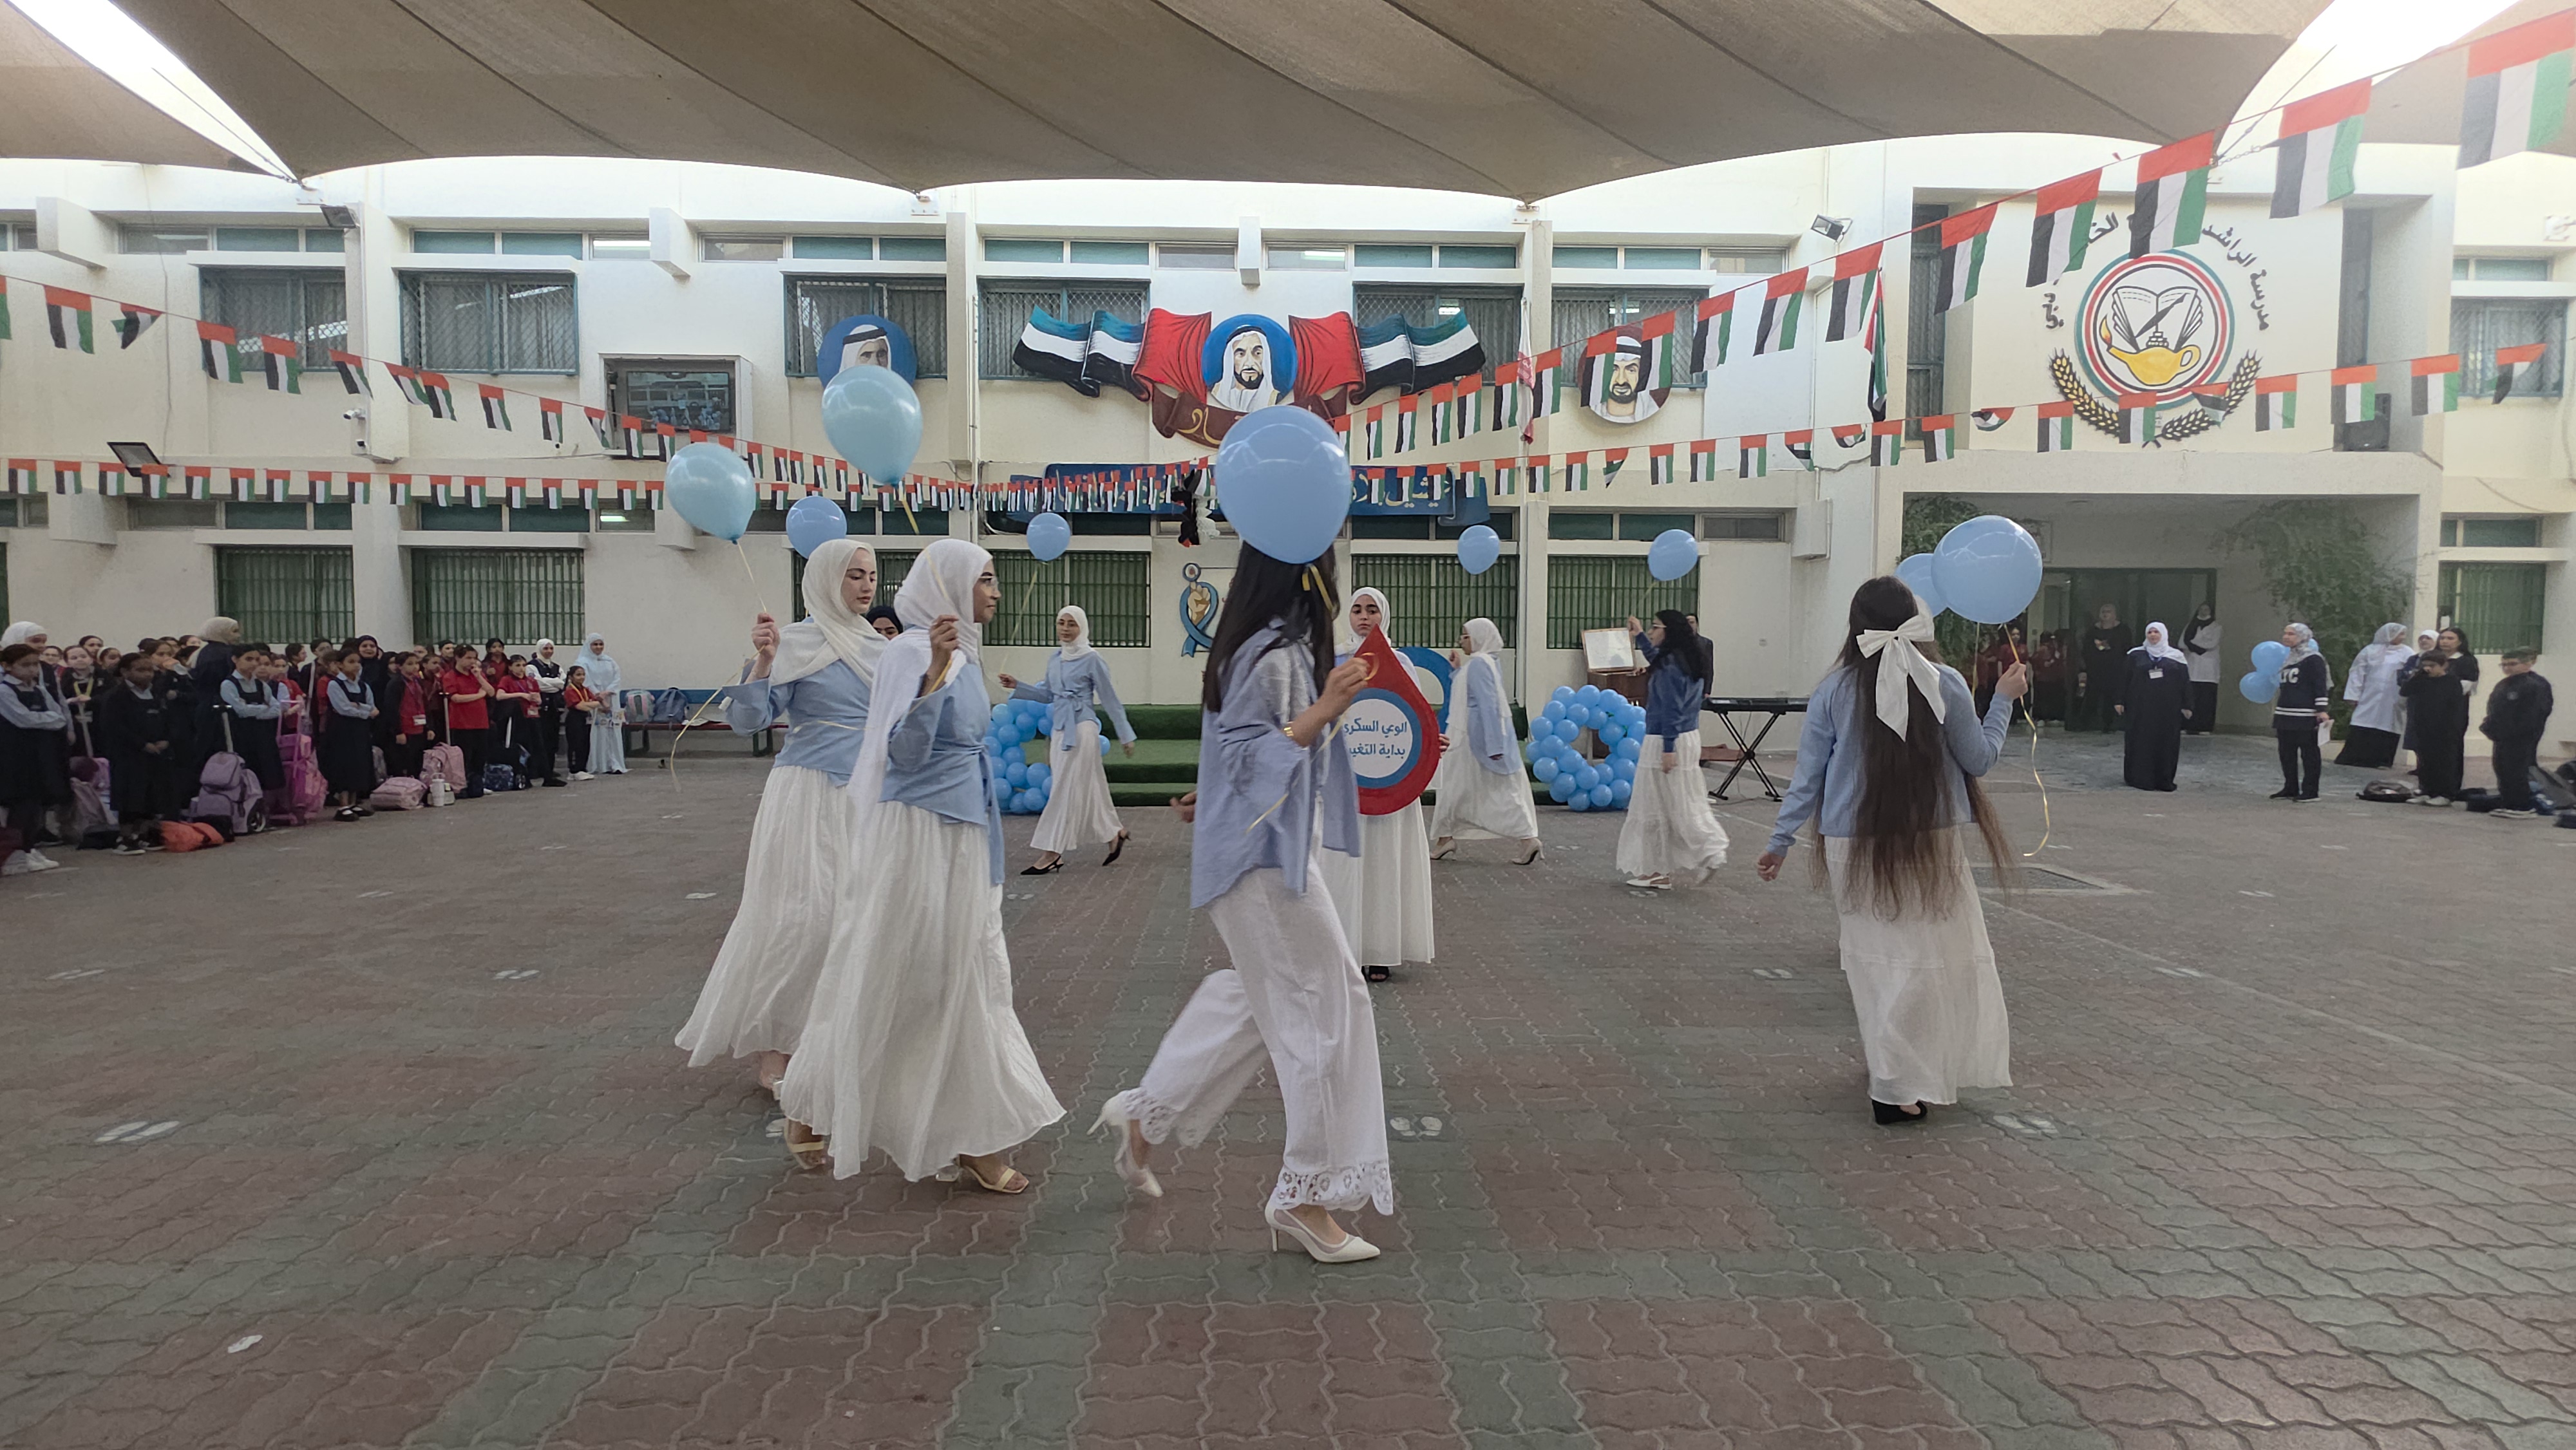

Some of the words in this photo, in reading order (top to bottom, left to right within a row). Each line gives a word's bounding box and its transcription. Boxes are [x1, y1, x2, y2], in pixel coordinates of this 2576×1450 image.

[2250, 269, 2269, 330] مدرسة
[1381, 720, 1407, 738] الوعي
[1379, 743, 1405, 759] بداية
